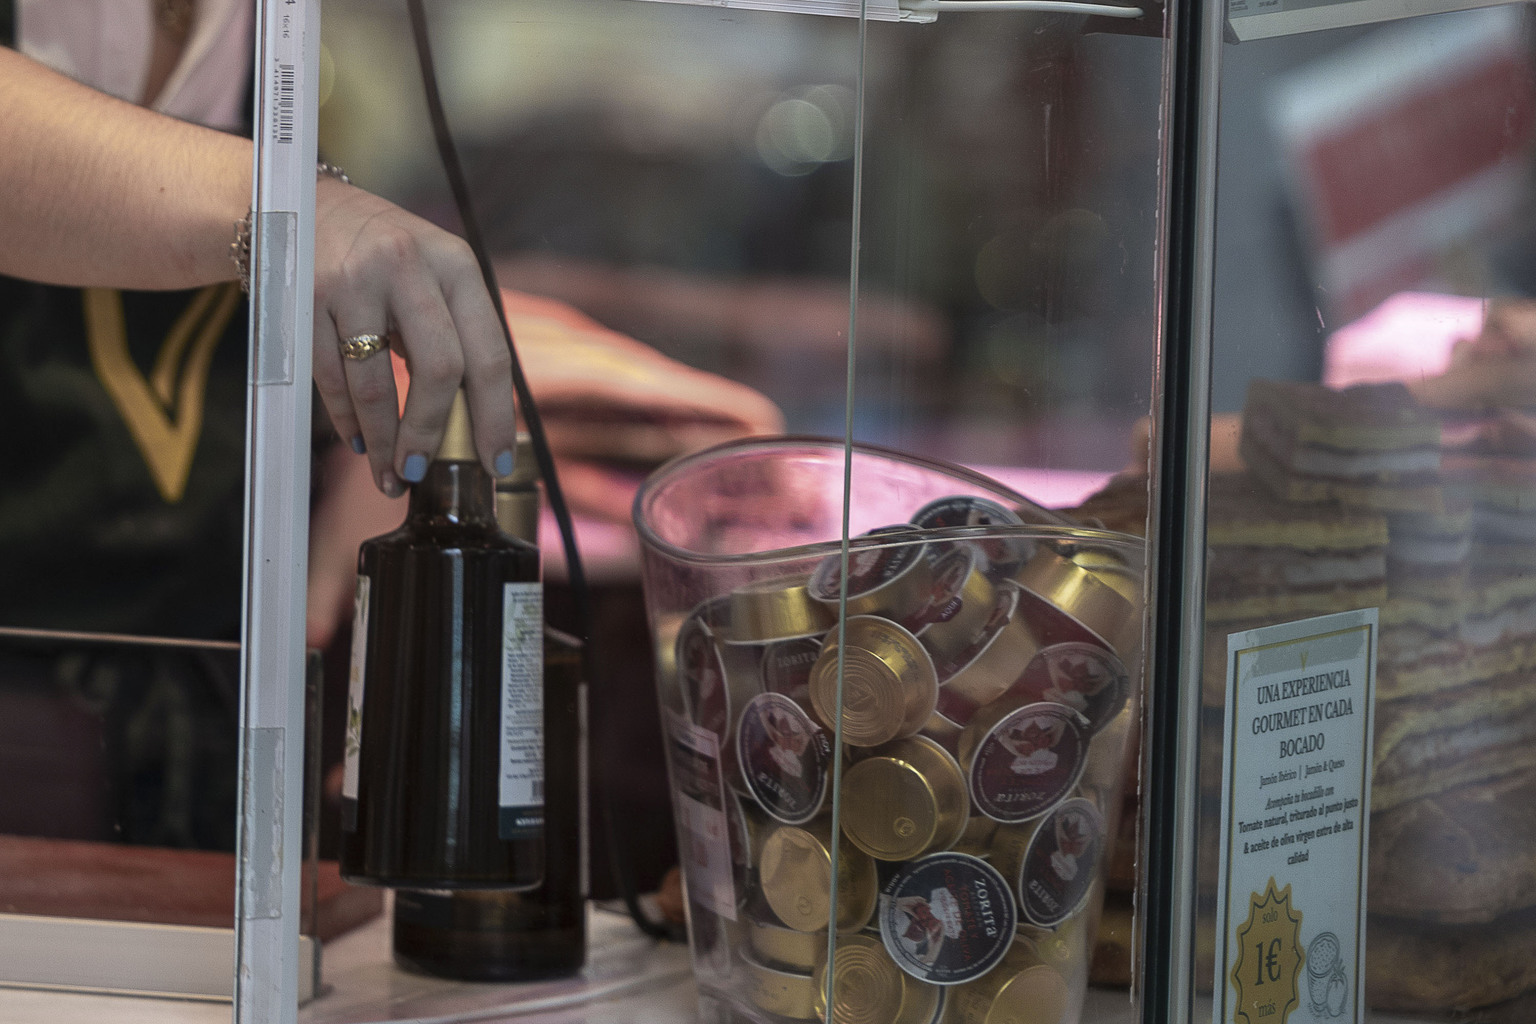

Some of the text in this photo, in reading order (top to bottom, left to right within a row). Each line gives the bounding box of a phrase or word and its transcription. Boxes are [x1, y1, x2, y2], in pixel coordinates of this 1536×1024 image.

[1257, 669, 1351, 705] UNA EXPERIENCIA
[1252, 697, 1354, 735] GOURMET EN CADA
[1279, 732, 1325, 759] BOCADO
[1238, 820, 1263, 834] Tomate
[1250, 838, 1270, 853] aceite
[1270, 836, 1279, 849] de
[1280, 833, 1295, 846] oliva
[1295, 829, 1315, 844] virgen
[1316, 825, 1333, 838] extra
[1333, 820, 1341, 834] de
[1342, 818, 1354, 832] alta
[1287, 849, 1310, 865] calidad
[1262, 907, 1279, 924] solo
[1254, 937, 1282, 987] 1€
[1258, 998, 1277, 1018] más
